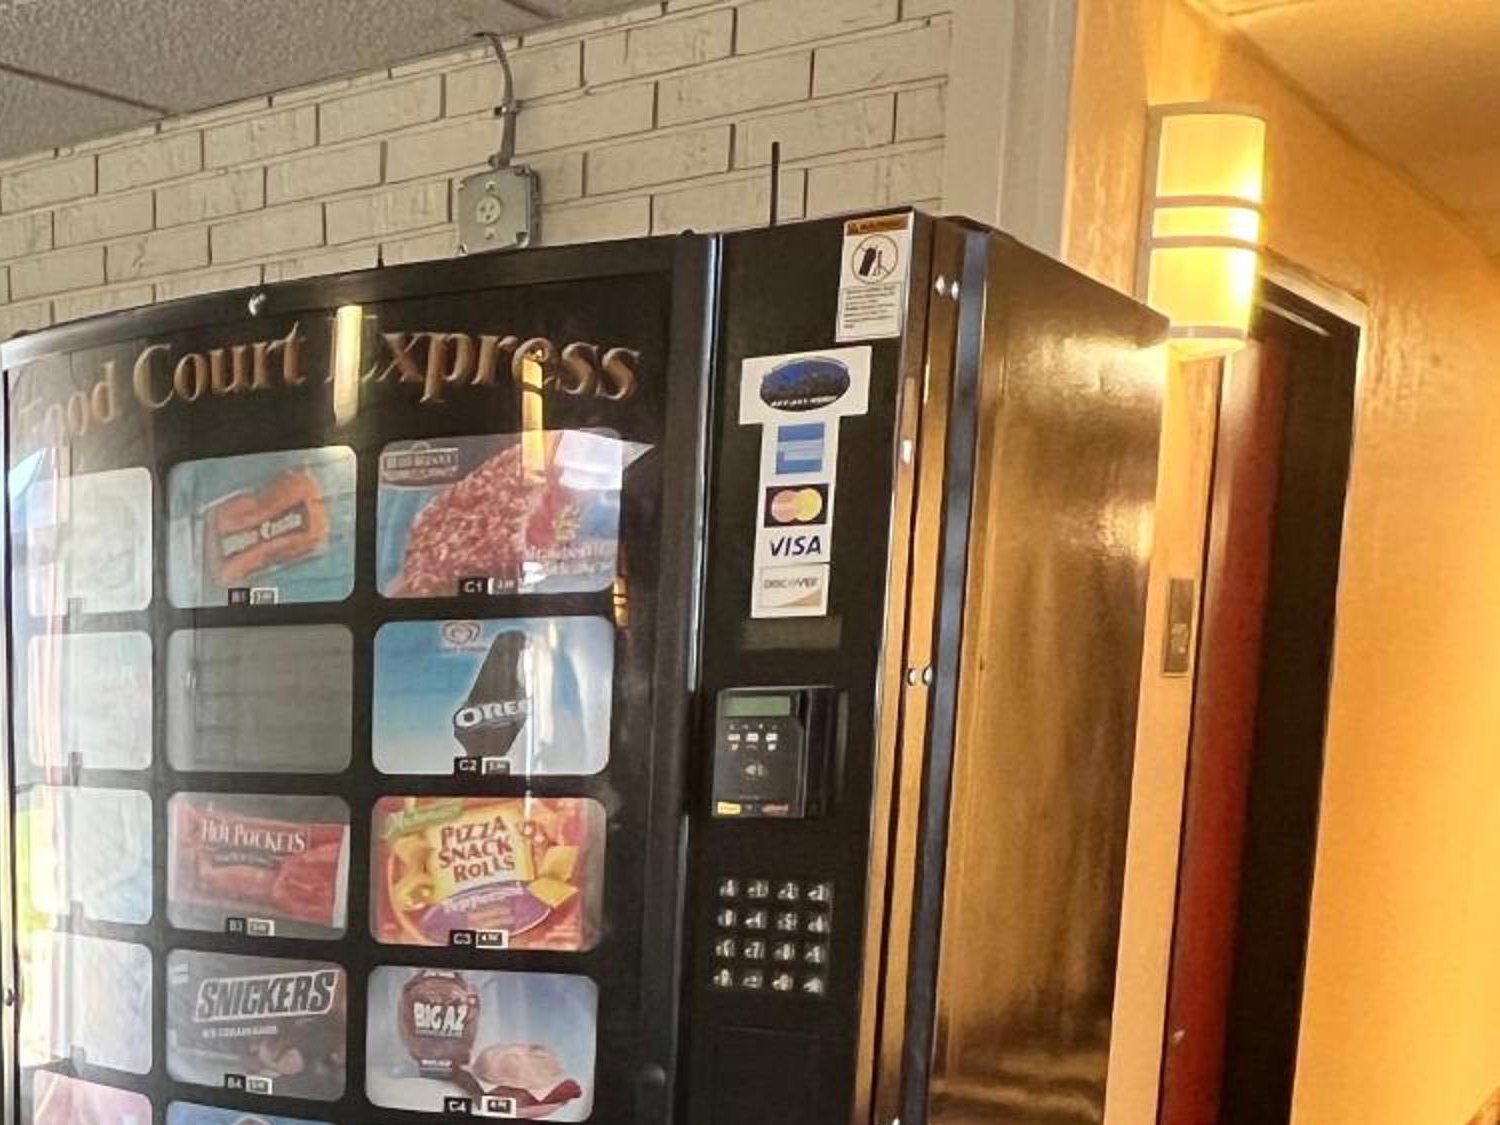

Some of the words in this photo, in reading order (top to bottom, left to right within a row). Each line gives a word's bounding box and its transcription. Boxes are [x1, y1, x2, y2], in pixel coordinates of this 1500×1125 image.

[132, 320, 306, 410] Court
[770, 535, 822, 557] VISA
[441, 815, 507, 844] PIZZA
[438, 839, 513, 868] SNACK
[453, 856, 515, 882] ROLLS
[200, 972, 338, 1020] SNICKERS
[413, 1001, 442, 1031] BIG
